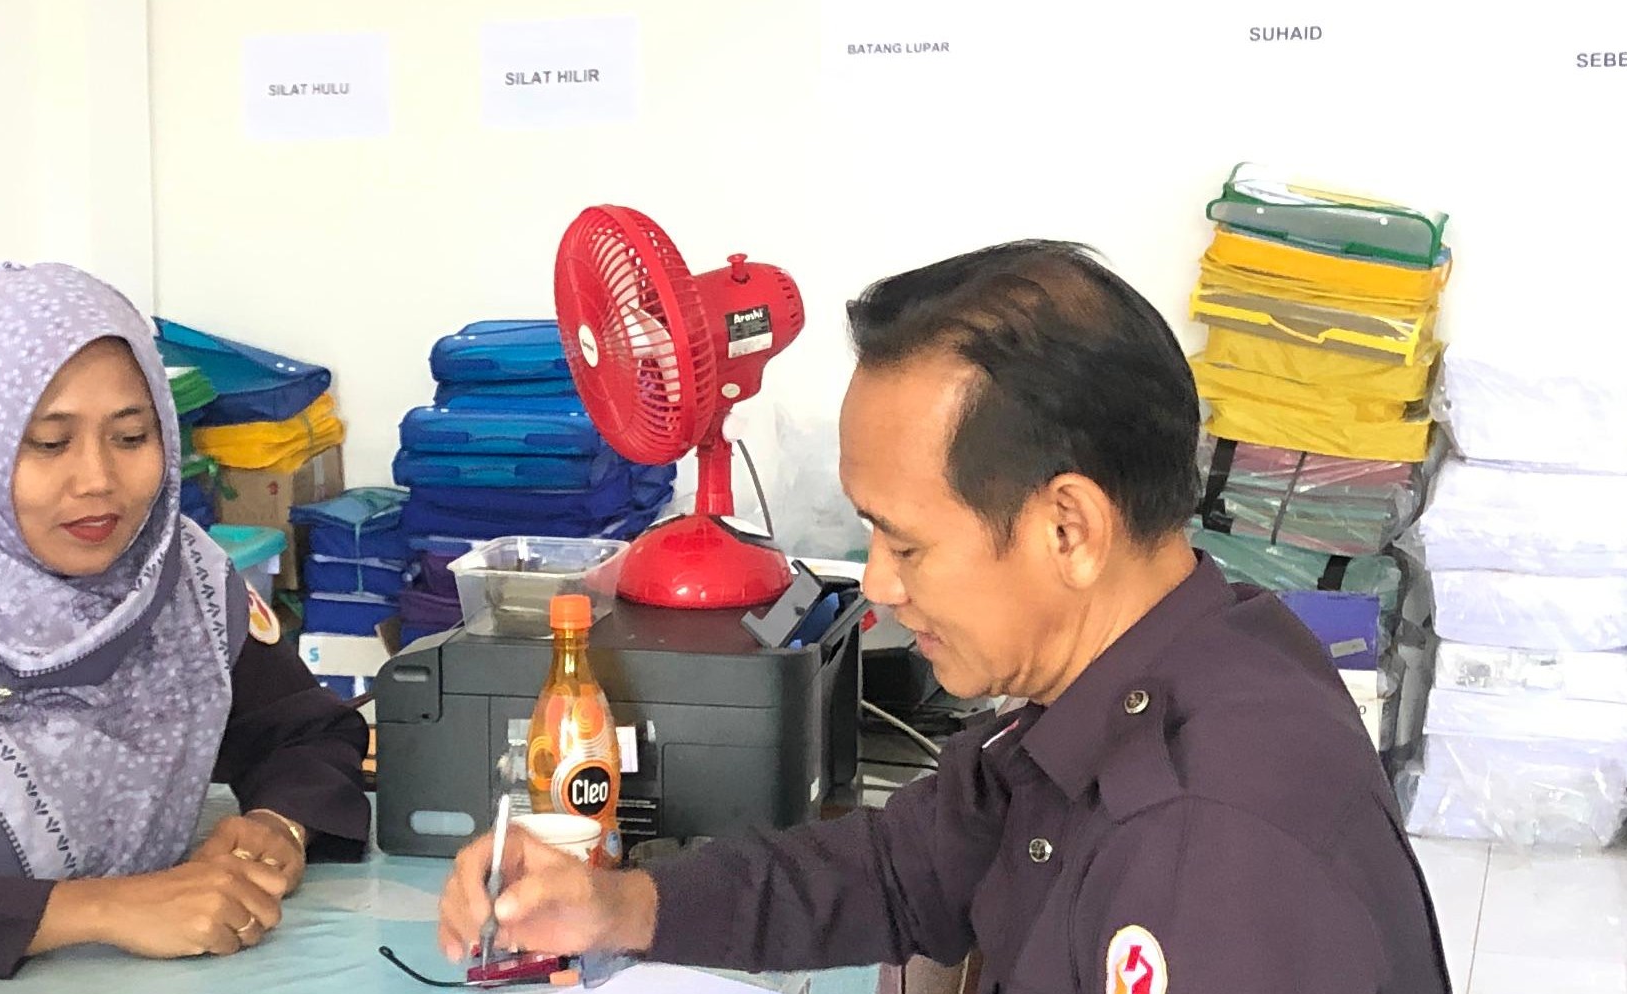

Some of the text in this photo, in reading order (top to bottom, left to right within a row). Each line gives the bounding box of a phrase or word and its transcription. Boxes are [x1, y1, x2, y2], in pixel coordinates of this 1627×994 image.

[1249, 26, 1323, 41] SUHAID
[847, 42, 950, 54] BATANG LUPAR
[1576, 51, 1627, 68] SEBE
[505, 68, 600, 86] SILAT HILIR
[268, 82, 350, 97] SILAT HULU
[572, 779, 609, 805] Cleo
